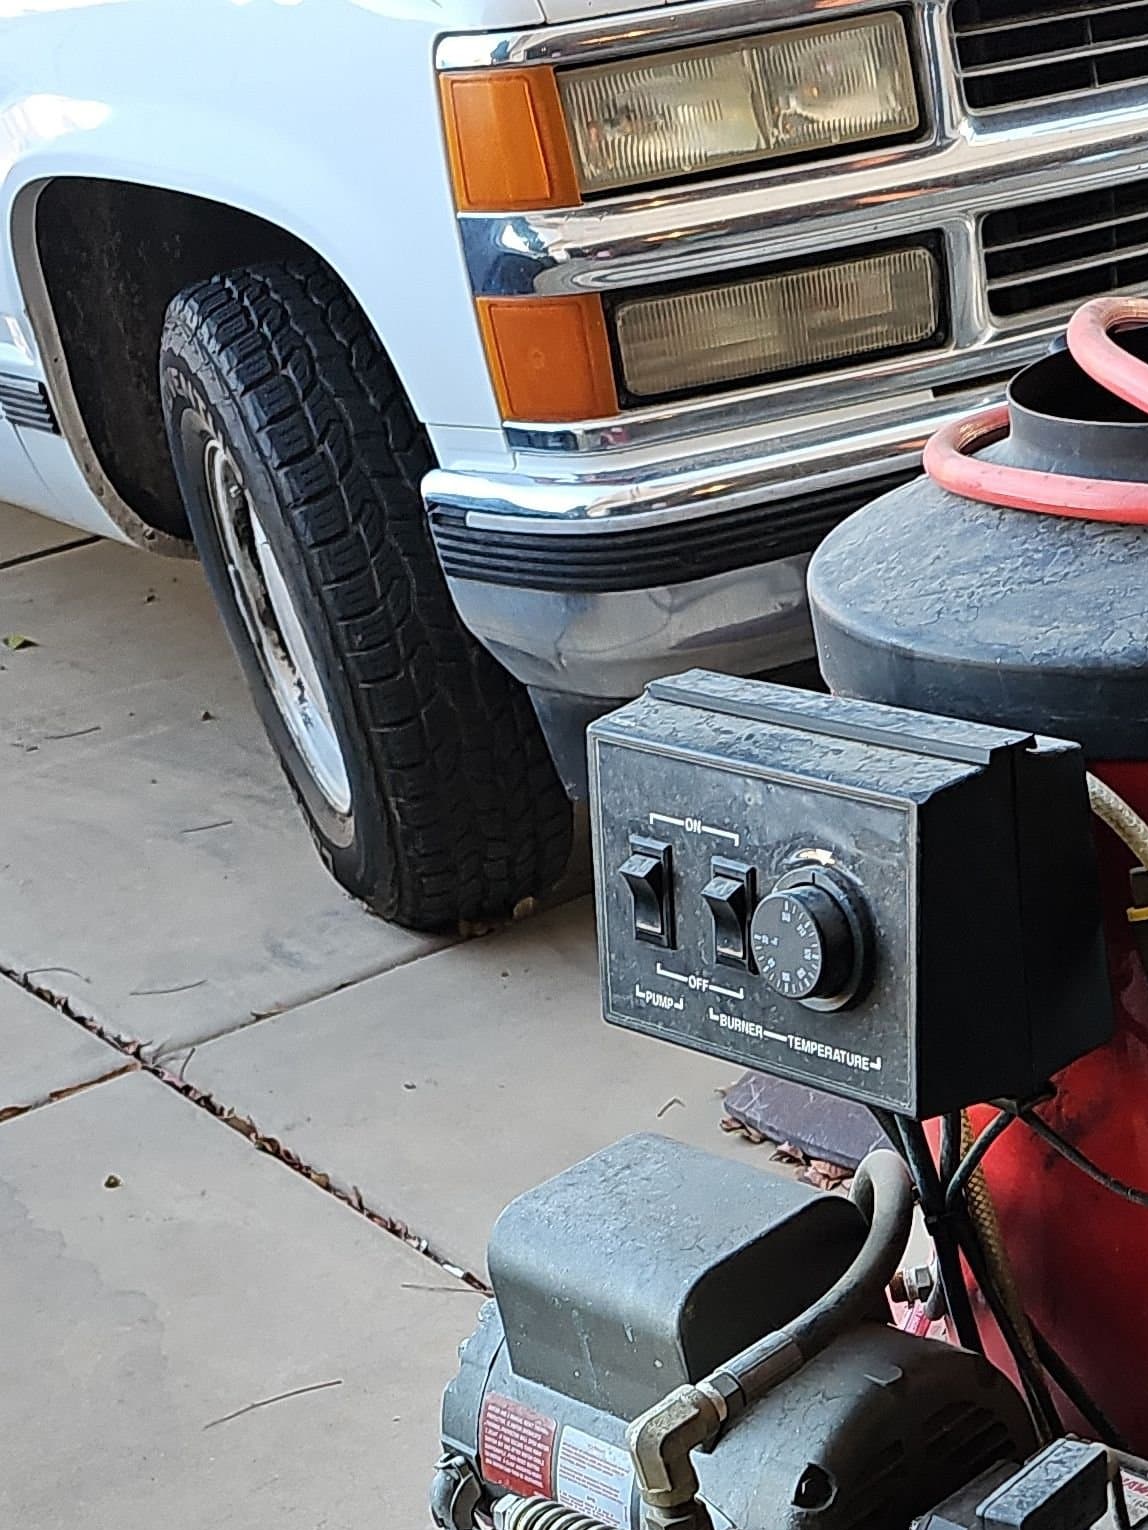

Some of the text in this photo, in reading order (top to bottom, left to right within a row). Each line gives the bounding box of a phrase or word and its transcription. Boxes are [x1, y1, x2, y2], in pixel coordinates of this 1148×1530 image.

[685, 818, 702, 833] ON
[688, 975, 709, 992] OFF
[645, 991, 673, 1009] PUMP
[719, 1013, 870, 1071] BURNER TEMPERATURE
